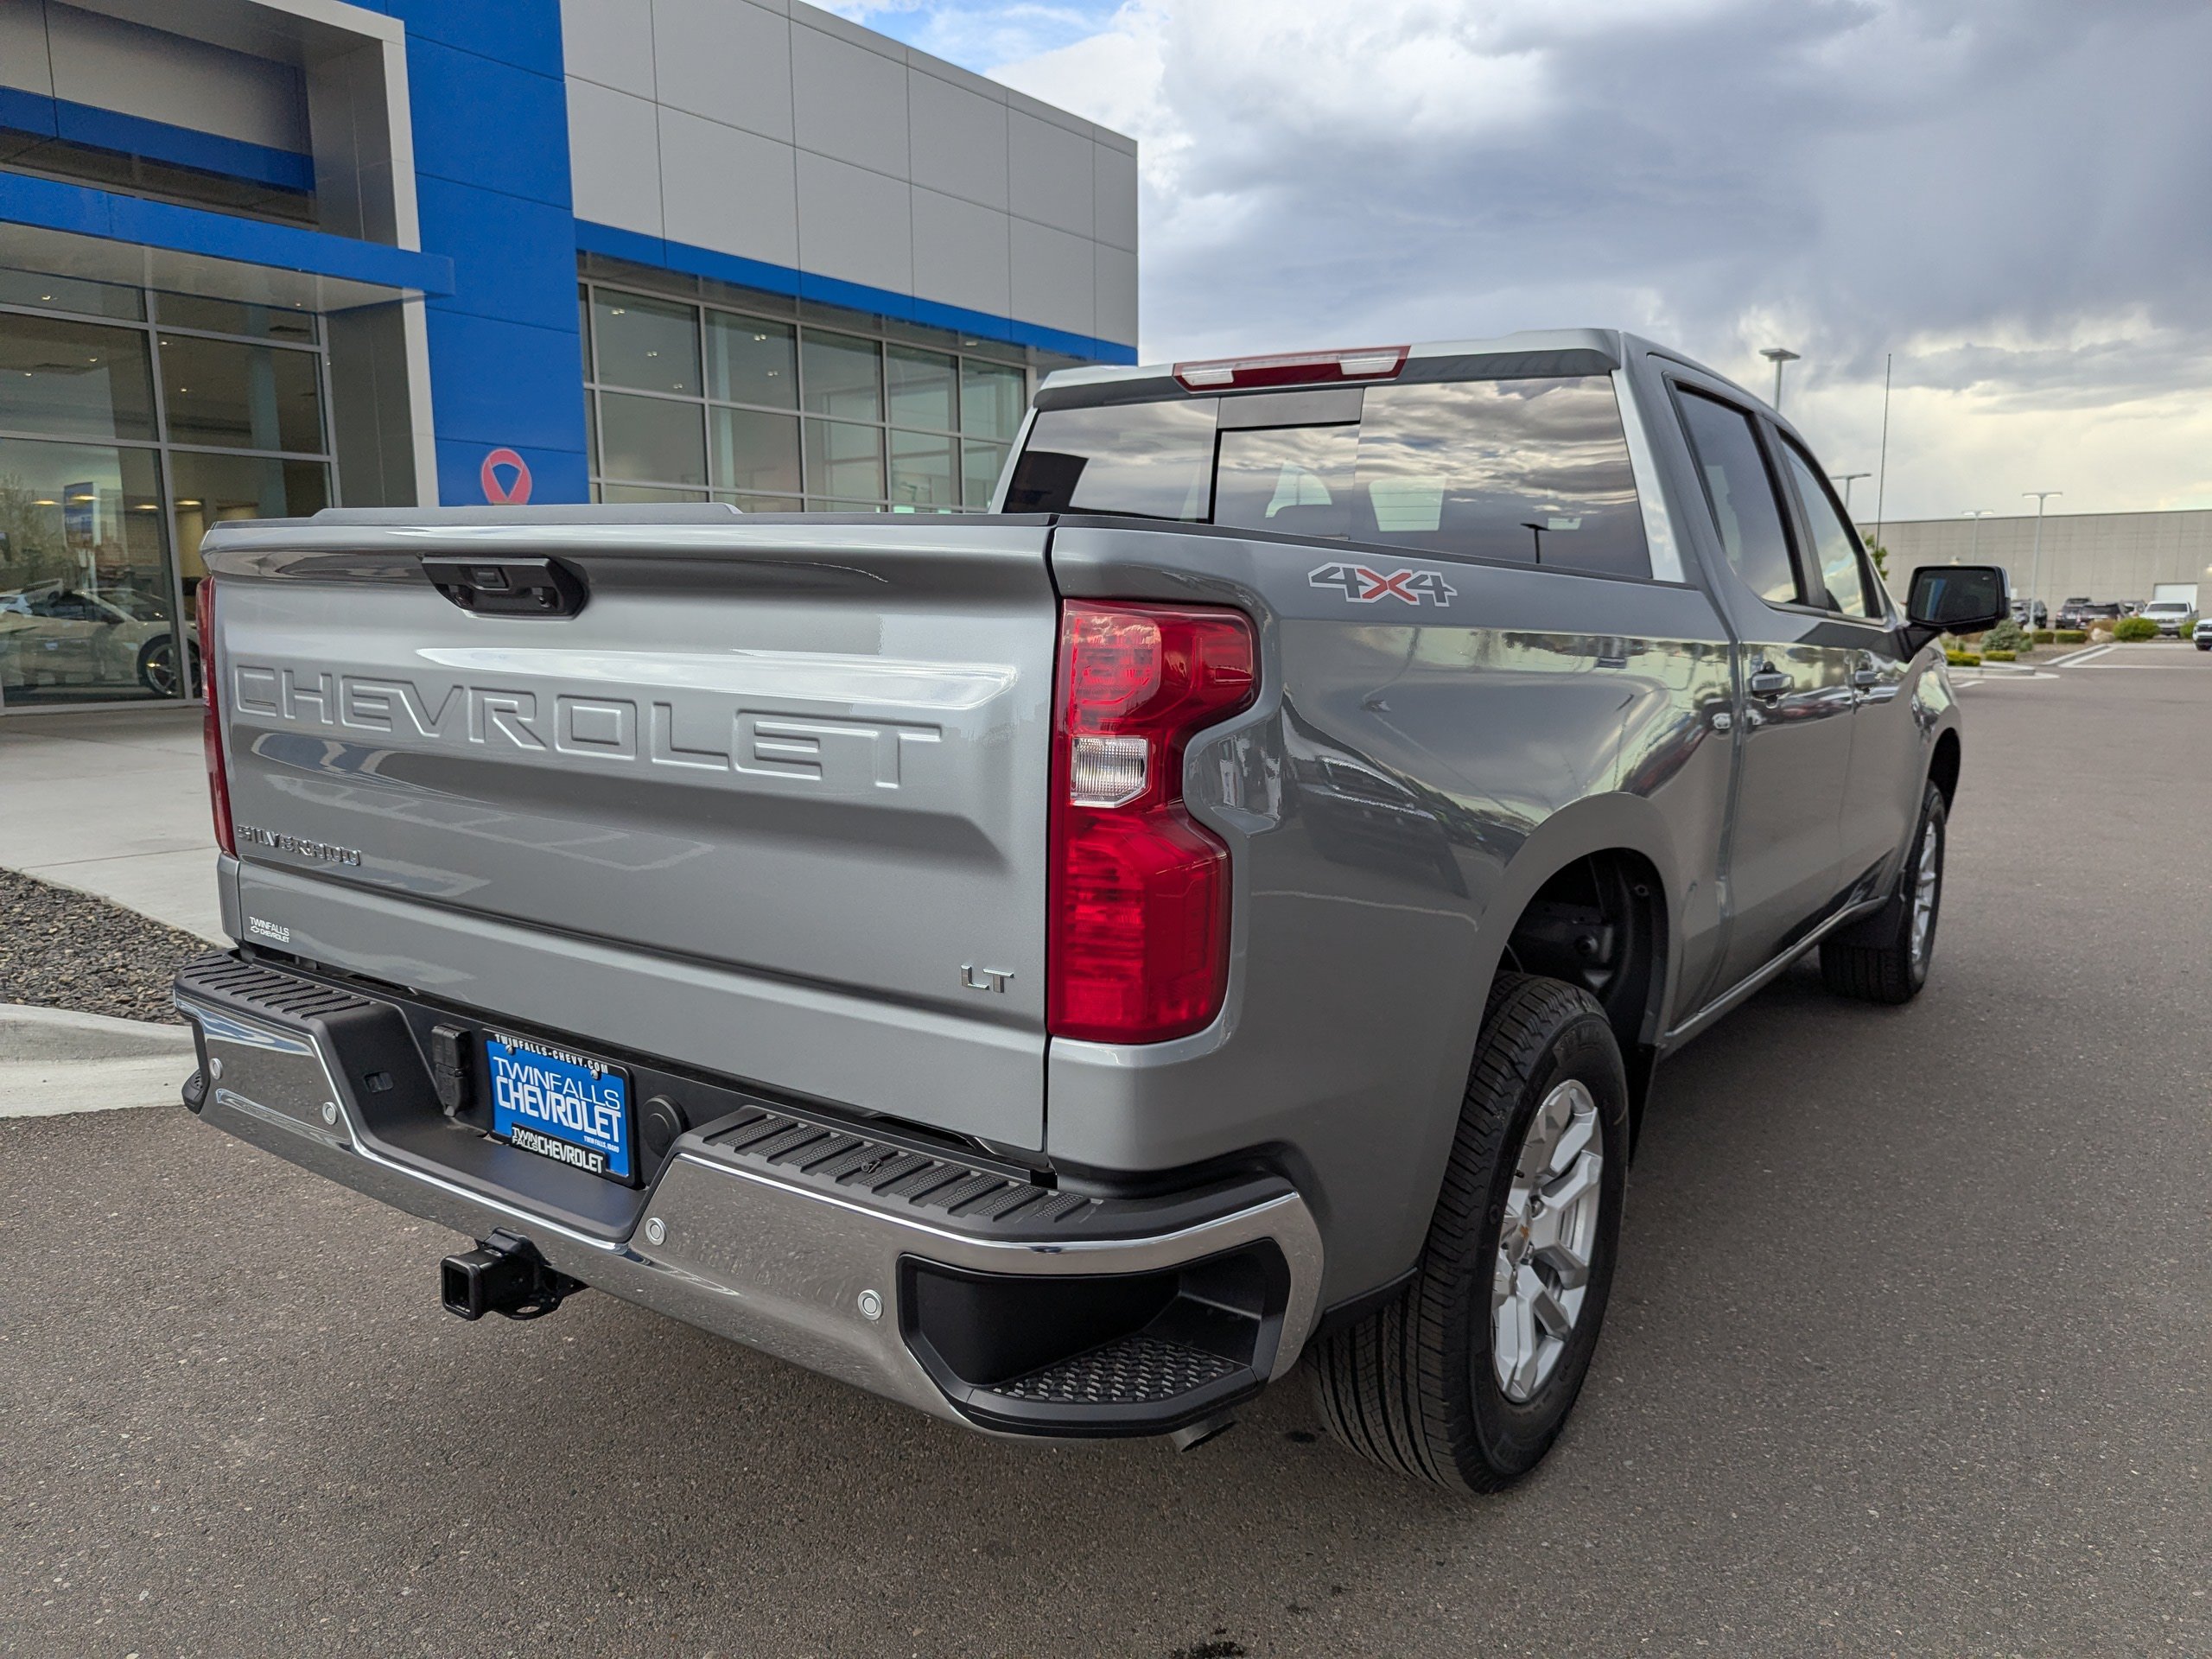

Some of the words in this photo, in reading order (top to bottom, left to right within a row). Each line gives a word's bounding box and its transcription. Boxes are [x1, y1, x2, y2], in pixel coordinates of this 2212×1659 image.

[236, 664, 942, 789] CHEVROLET
[238, 824, 361, 867] SILVERADO
[250, 916, 289, 937] TWINFALLS
[260, 928, 289, 944] CHEVROLET
[961, 964, 1014, 993] LT
[495, 1033, 608, 1074] TWINFALLS-CHEVY.COM
[493, 1056, 620, 1110] TWINFALLS
[496, 1076, 621, 1143] CHEVROLET
[512, 1127, 538, 1142] TWIN
[512, 1136, 538, 1152] FALLS
[537, 1136, 604, 1173] CHEVROLET
